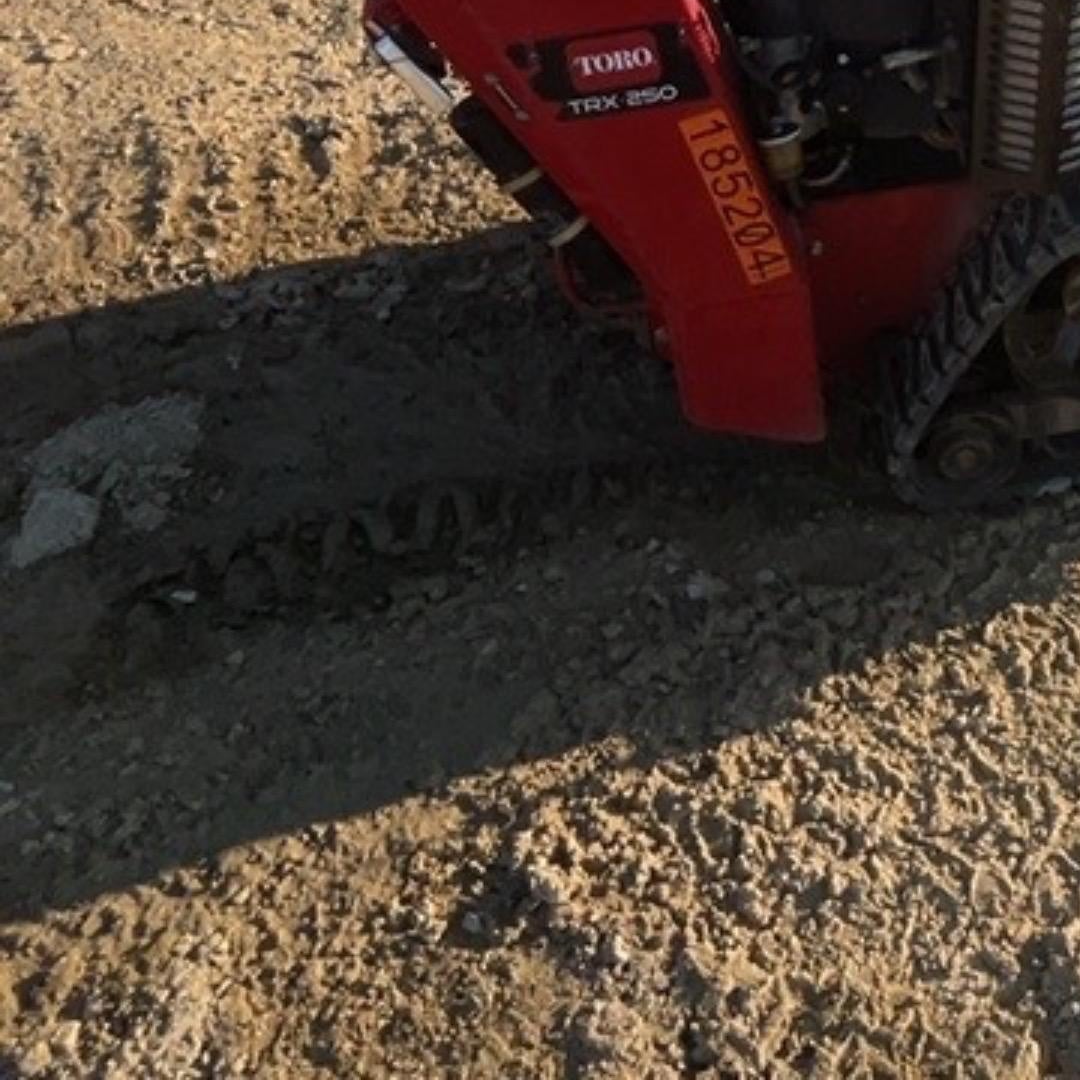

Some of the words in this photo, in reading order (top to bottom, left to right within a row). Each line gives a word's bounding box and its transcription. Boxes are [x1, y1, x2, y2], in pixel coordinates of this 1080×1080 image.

[572, 46, 653, 76] TORO
[567, 94, 620, 115] TRX
[625, 83, 679, 107] 250
[689, 118, 787, 280] 185204
